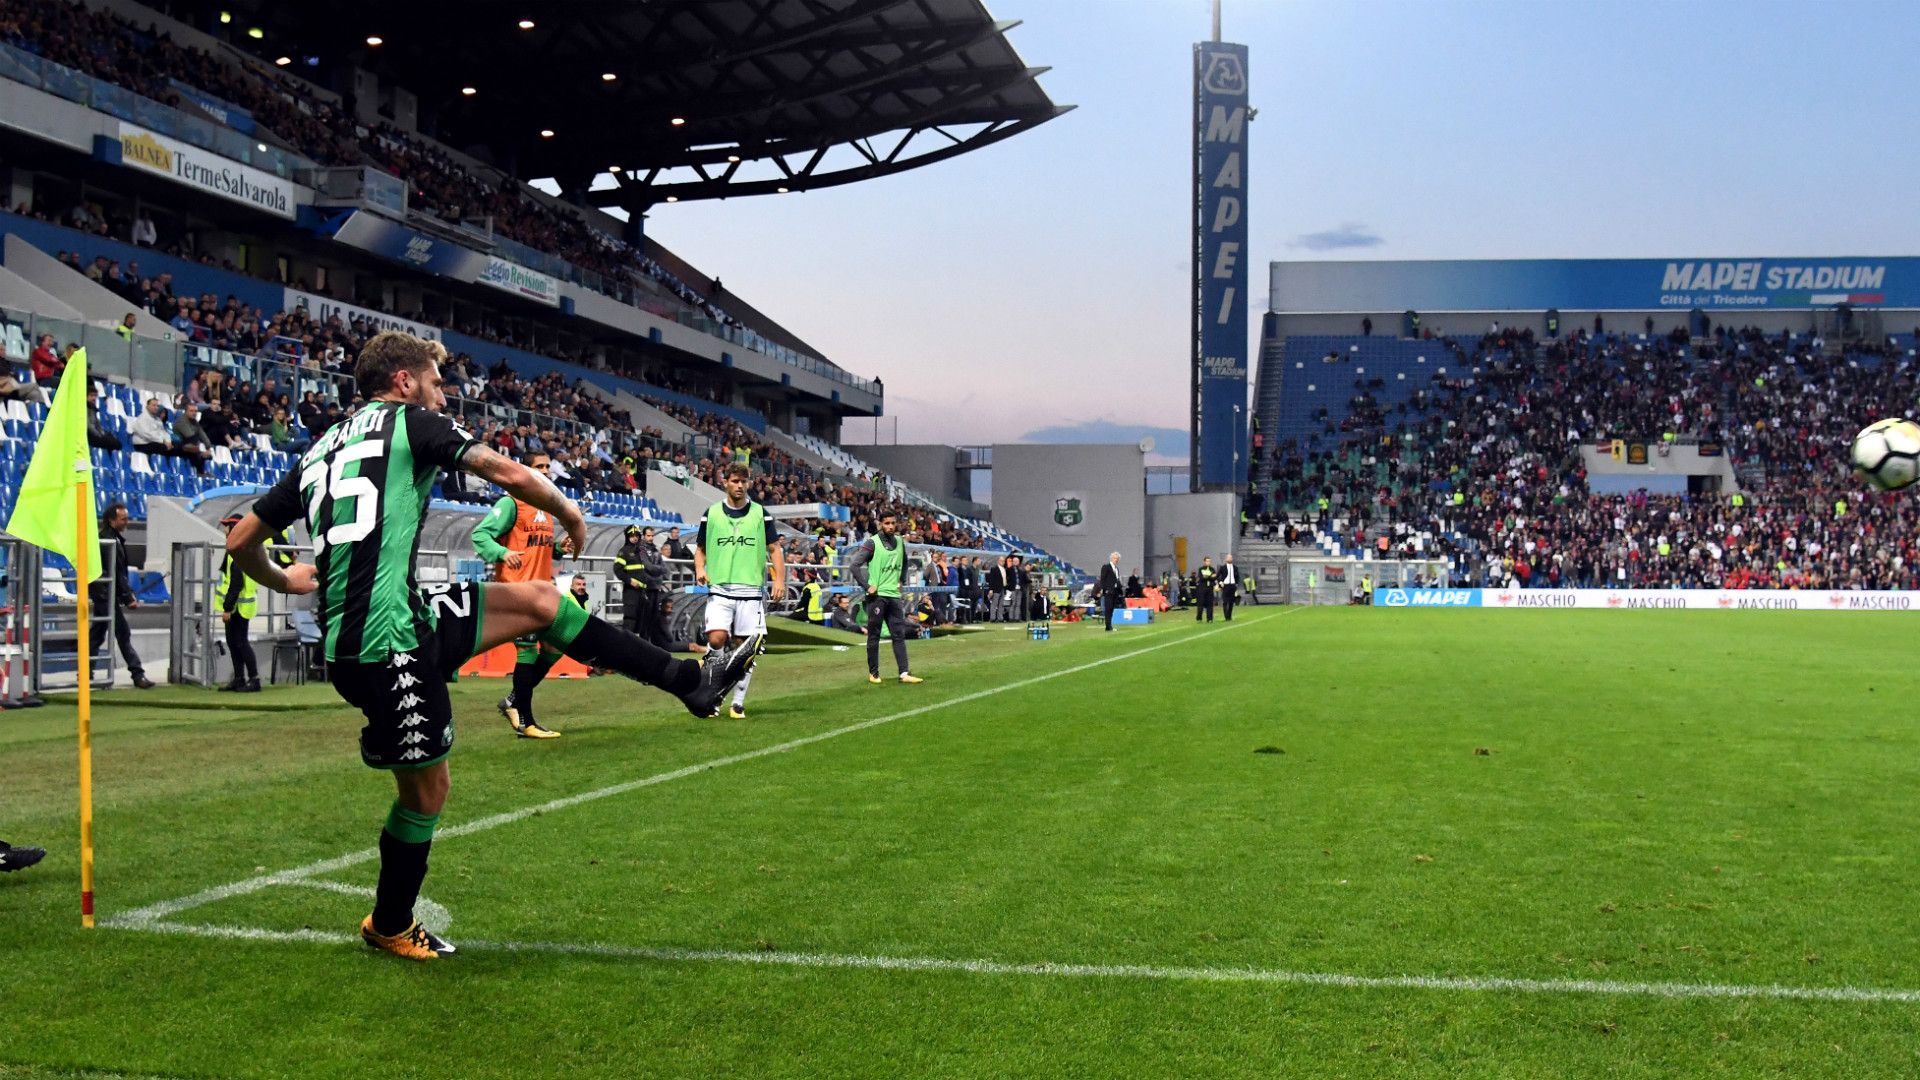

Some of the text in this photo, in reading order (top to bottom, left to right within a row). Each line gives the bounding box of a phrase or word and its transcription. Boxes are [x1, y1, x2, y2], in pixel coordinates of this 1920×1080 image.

[124, 139, 287, 212] BALNEA TermeSalvarola
[1206, 105, 1244, 324] MAPEI
[1661, 262, 1886, 290] MAPEI STADIUM
[1660, 293, 1691, 305] Città
[1713, 295, 1768, 305] Tricolore
[717, 535, 756, 547] FAAC
[1412, 591, 1471, 605] MAPEI
[1517, 594, 1576, 607] MASCHIO
[1627, 597, 1686, 609] MASCHIO
[1738, 598, 1798, 609] MASCHIO
[1849, 596, 1910, 609] MASCHIO
